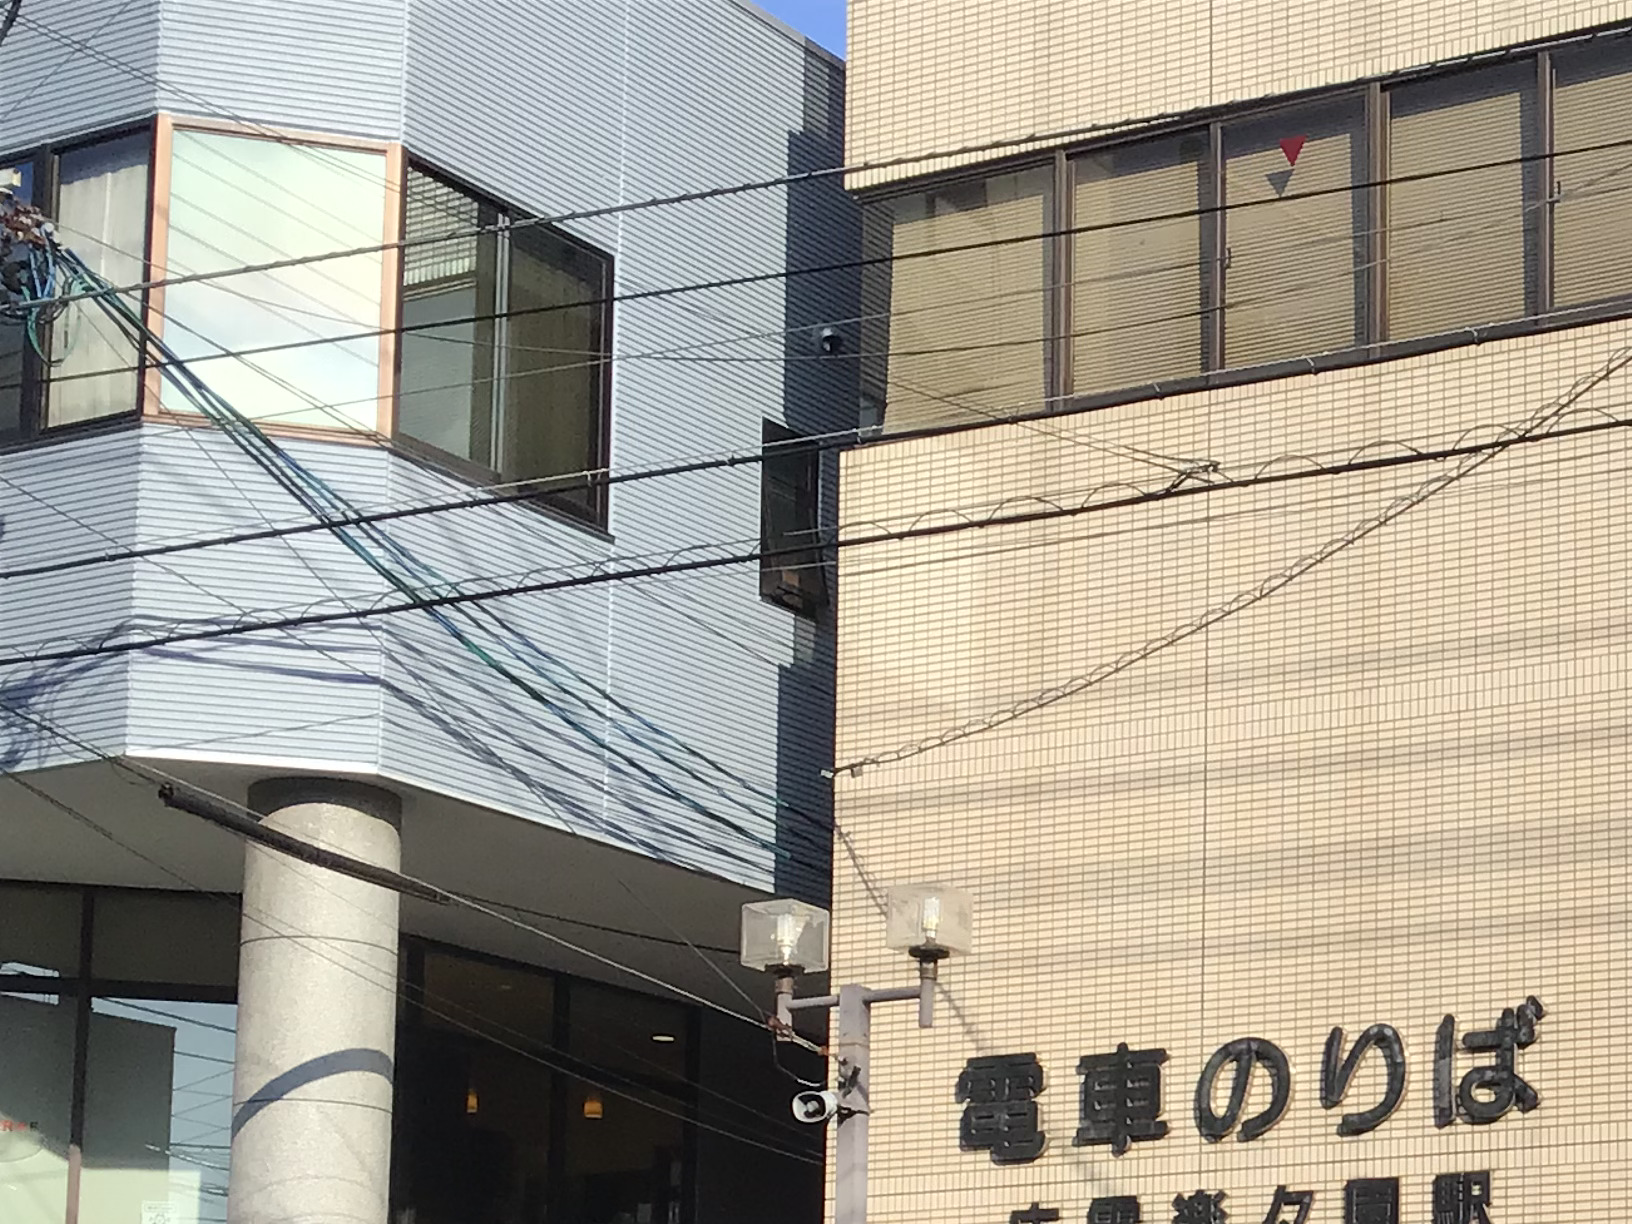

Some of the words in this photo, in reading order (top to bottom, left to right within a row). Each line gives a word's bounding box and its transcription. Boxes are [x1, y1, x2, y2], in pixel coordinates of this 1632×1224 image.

[955, 994, 1548, 1166] 電車のりば
